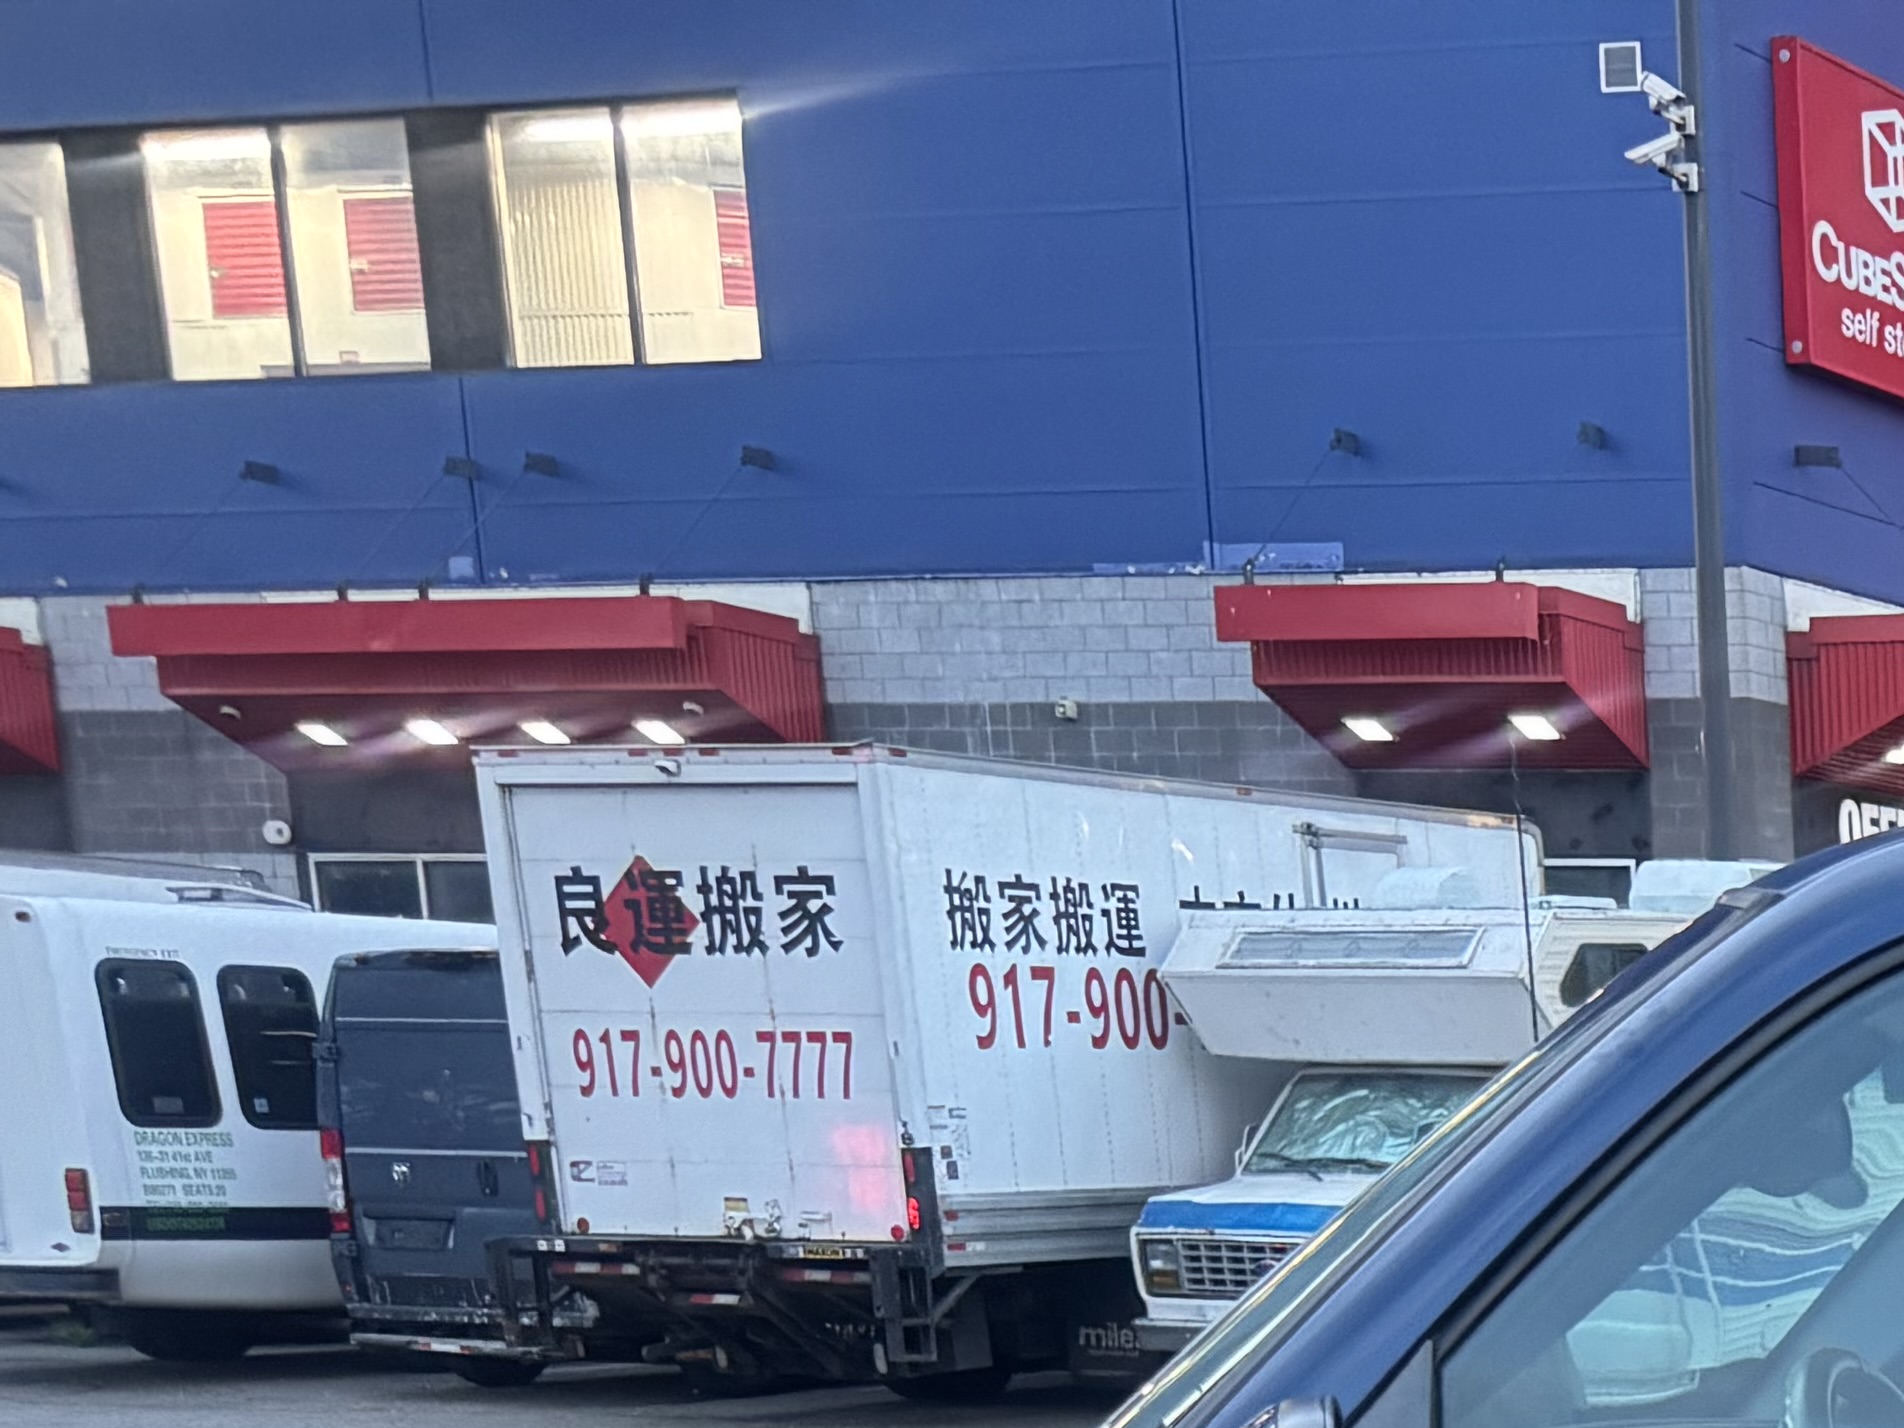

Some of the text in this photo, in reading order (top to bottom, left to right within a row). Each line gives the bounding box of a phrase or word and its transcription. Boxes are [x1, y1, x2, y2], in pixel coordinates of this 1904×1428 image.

[1840, 307, 1880, 348] self
[554, 865, 844, 957] 良運搬家
[943, 868, 1147, 958] 搬家搬運
[572, 1027, 853, 1100] 917-900-7777
[134, 1131, 234, 1148] DRAGON EXPRESS
[1079, 1321, 1141, 1349] mile
